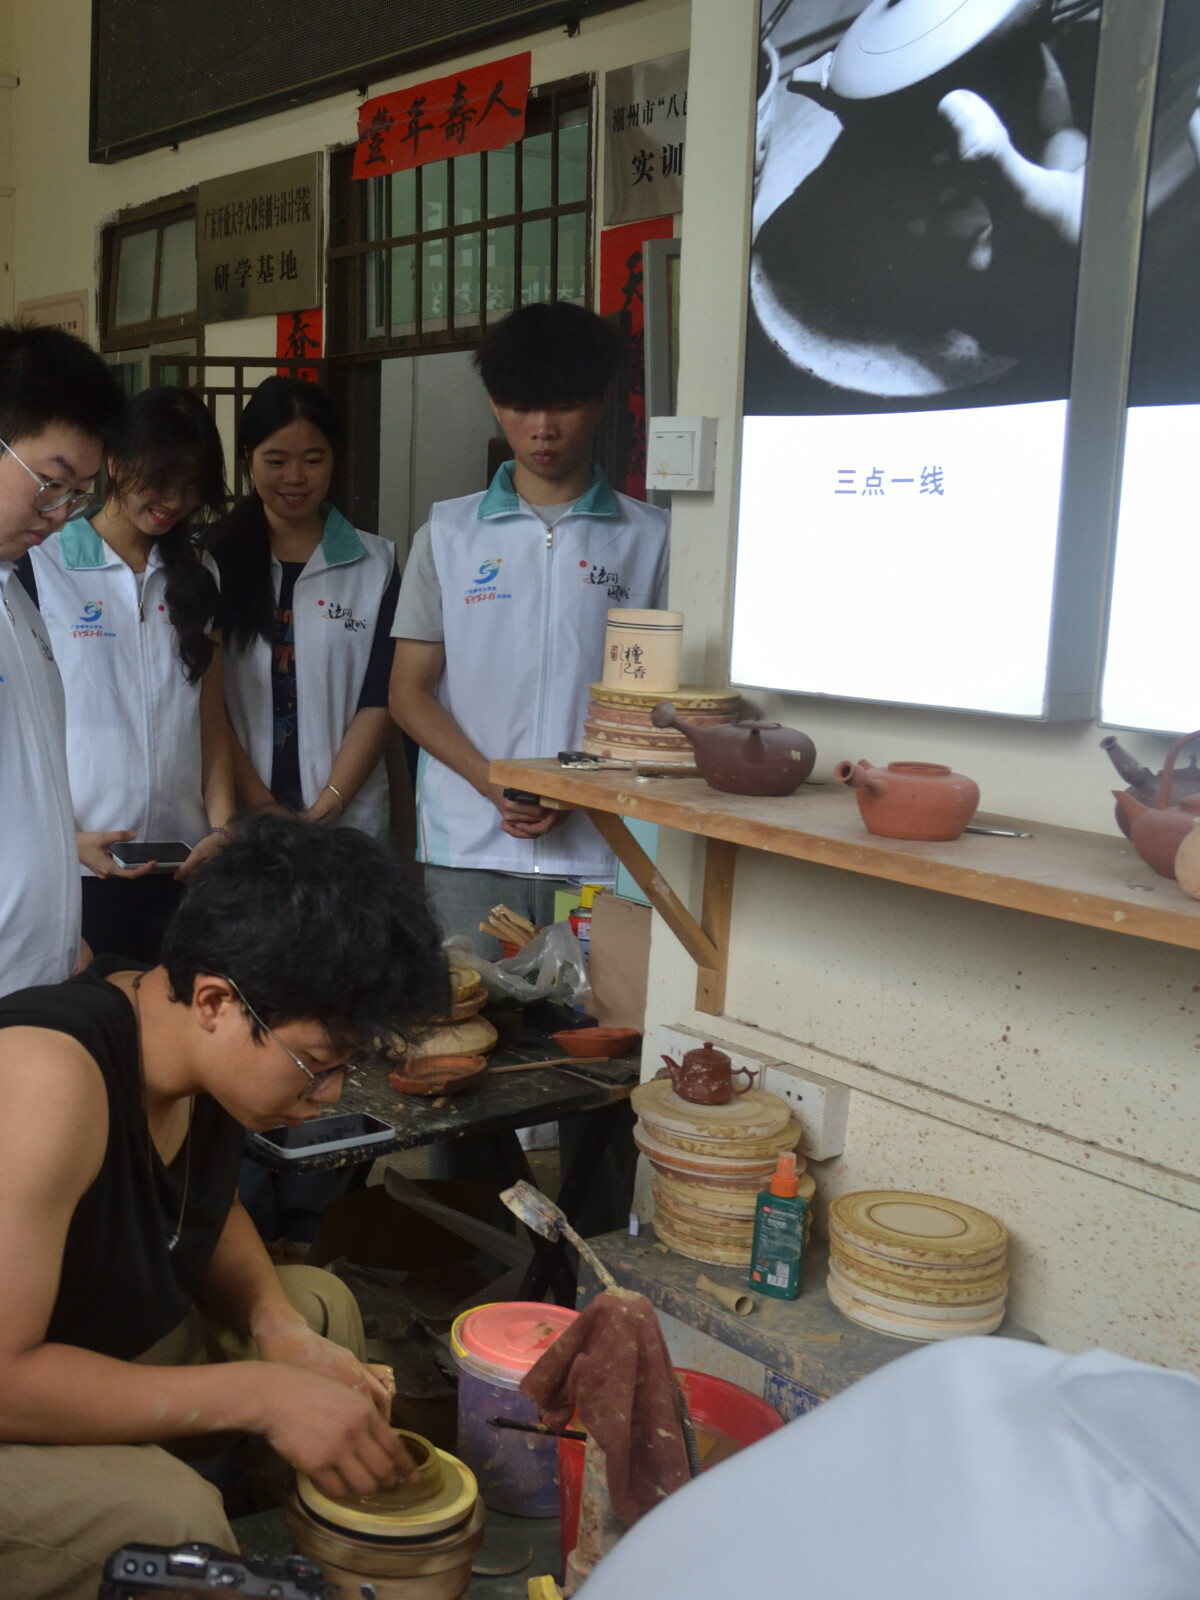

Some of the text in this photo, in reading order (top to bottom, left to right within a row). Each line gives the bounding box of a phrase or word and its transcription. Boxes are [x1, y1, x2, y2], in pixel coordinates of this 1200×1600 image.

[214, 250, 298, 292] 研学基地
[834, 465, 945, 496] 三点一线
